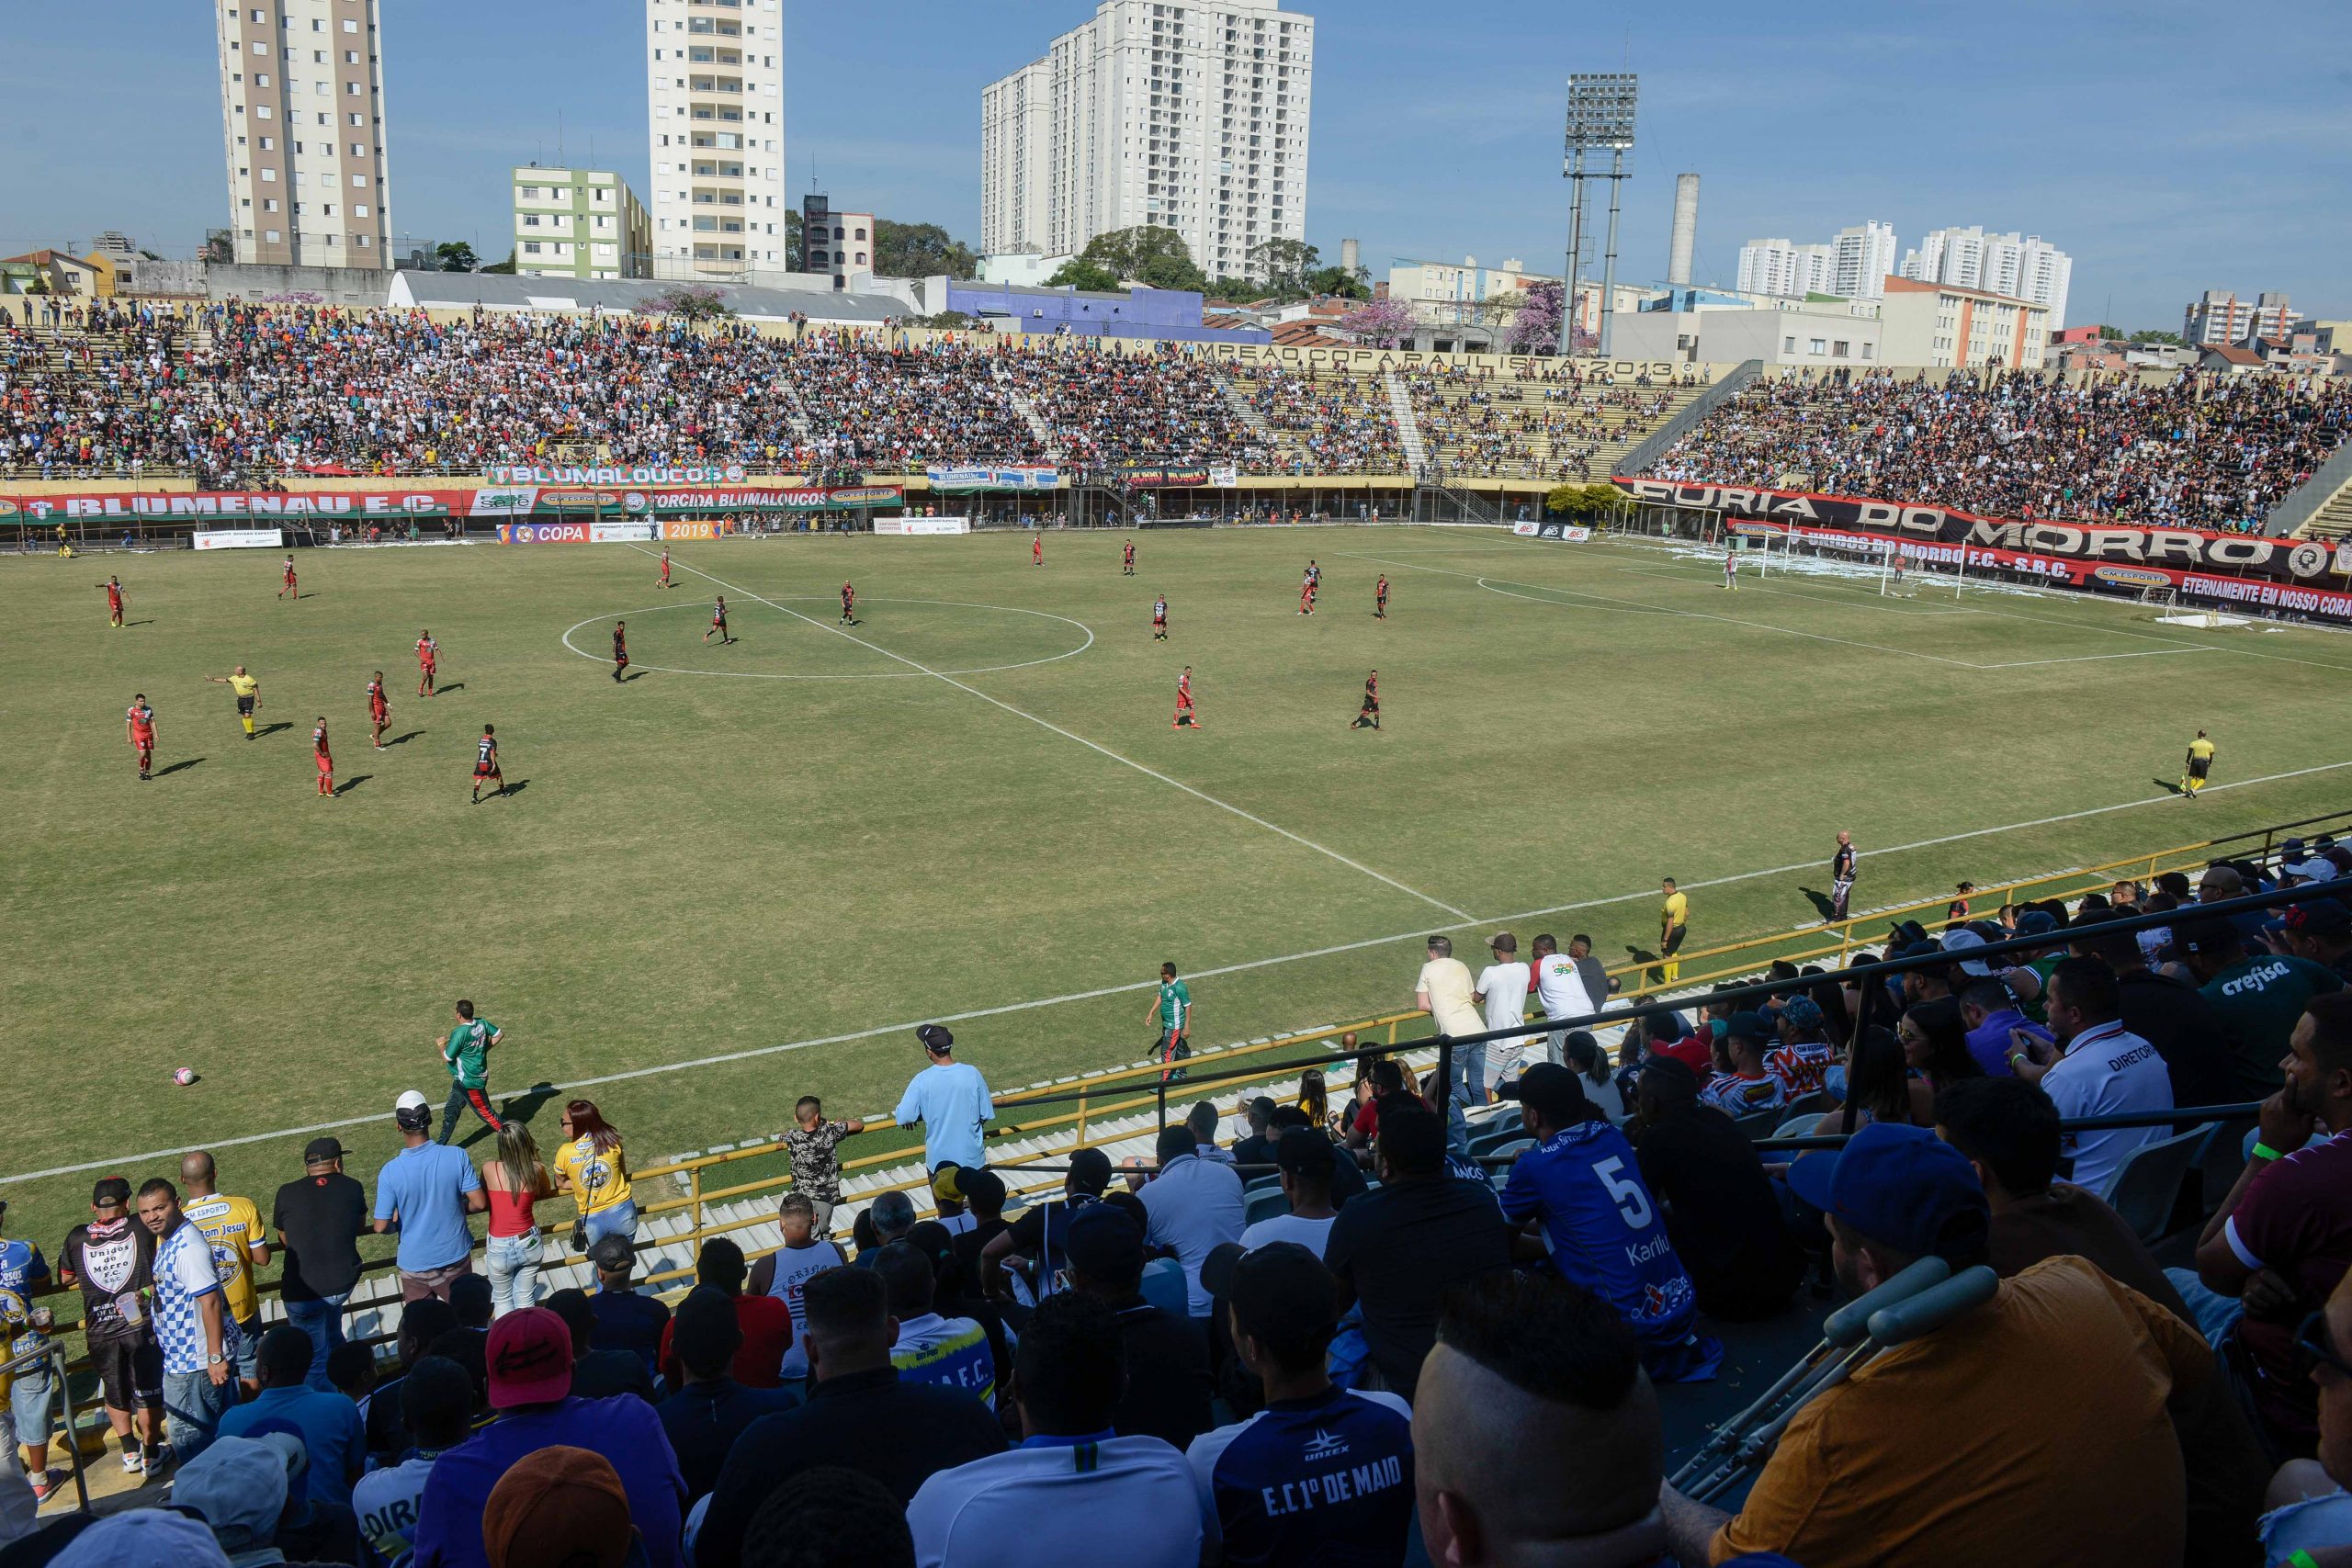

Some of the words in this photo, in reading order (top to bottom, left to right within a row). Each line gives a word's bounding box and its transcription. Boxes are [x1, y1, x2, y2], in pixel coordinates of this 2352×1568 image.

[1155, 343, 1299, 361] AMPEAO
[1309, 348, 1395, 365] COPA
[512, 467, 723, 483] BLUMALOUCOS
[67, 496, 351, 517] BLUMENAU
[365, 495, 447, 513] E.C.
[649, 493, 714, 507] TORCIDA
[718, 492, 828, 506] BLUMALOUCOS
[538, 526, 584, 541] COPA
[671, 524, 709, 538] 2019
[1855, 502, 1946, 532] DO
[1963, 519, 2274, 565] MORRO
[1900, 542, 1964, 563] MORRO
[1968, 551, 1999, 568] F.C.
[2014, 557, 2070, 579] S.B.C.
[2120, 572, 2165, 582] ESPORTE
[2181, 577, 2260, 602] ETERNAMENTE
[2260, 586, 2278, 605] EM
[2278, 590, 2318, 612] NOSSO
[2320, 596, 2352, 617] CORA
[480, 747, 488, 761] 7
[2222, 961, 2290, 996] crefisa
[1591, 1155, 1653, 1230] 5
[198, 1205, 228, 1216] ESPORTE
[222, 1223, 246, 1235] Jesus
[90, 1245, 130, 1258] Unidos
[94, 1261, 129, 1273] Morro
[1261, 1482, 1299, 1517] E.C
[1322, 1471, 1352, 1505] DE
[1351, 1454, 1402, 1497] MAIO
